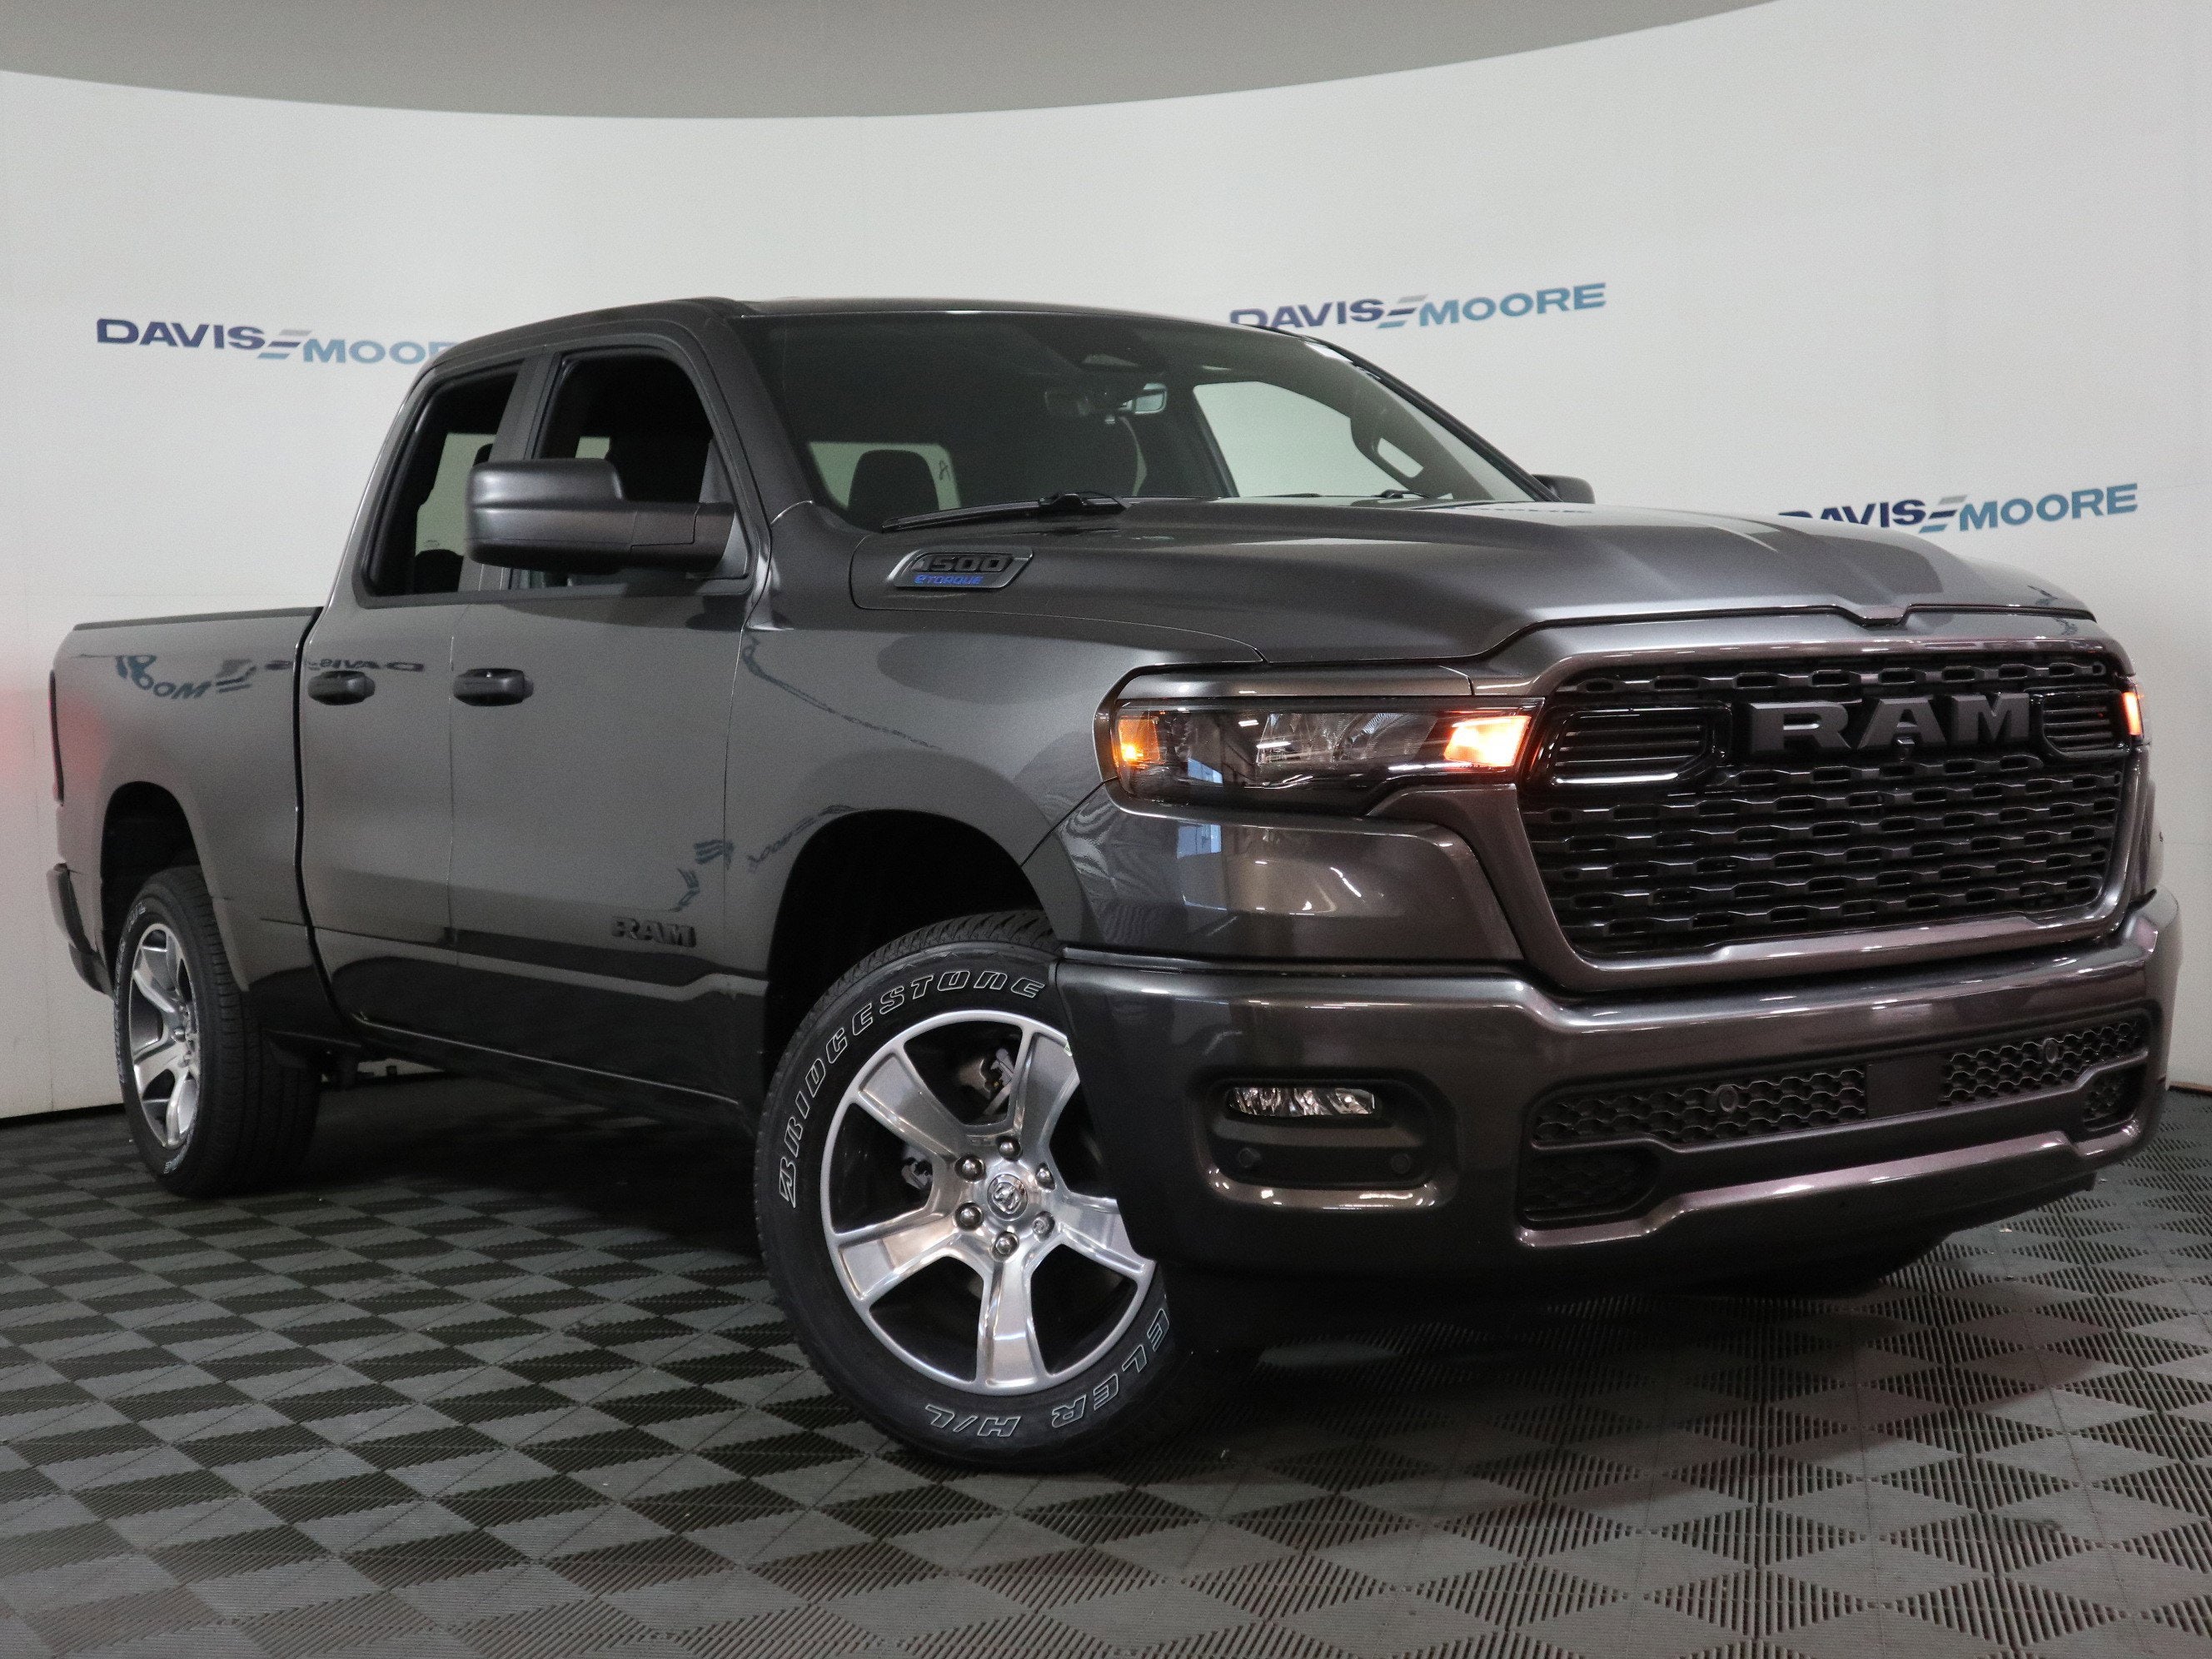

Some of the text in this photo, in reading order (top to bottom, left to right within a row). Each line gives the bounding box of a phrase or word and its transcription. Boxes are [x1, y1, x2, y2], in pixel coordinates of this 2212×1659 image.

[1230, 282, 1606, 328] DAVIS MOORE
[96, 318, 459, 365] DAVIS MOO
[1778, 483, 2138, 531] AVIS MOORE
[914, 555, 1011, 571] 1500
[1750, 693, 2030, 750] RAM
[611, 917, 696, 948] RAM
[779, 970, 1045, 1208] BRIDGESTONE
[924, 1308, 1170, 1437] ELER H/L
